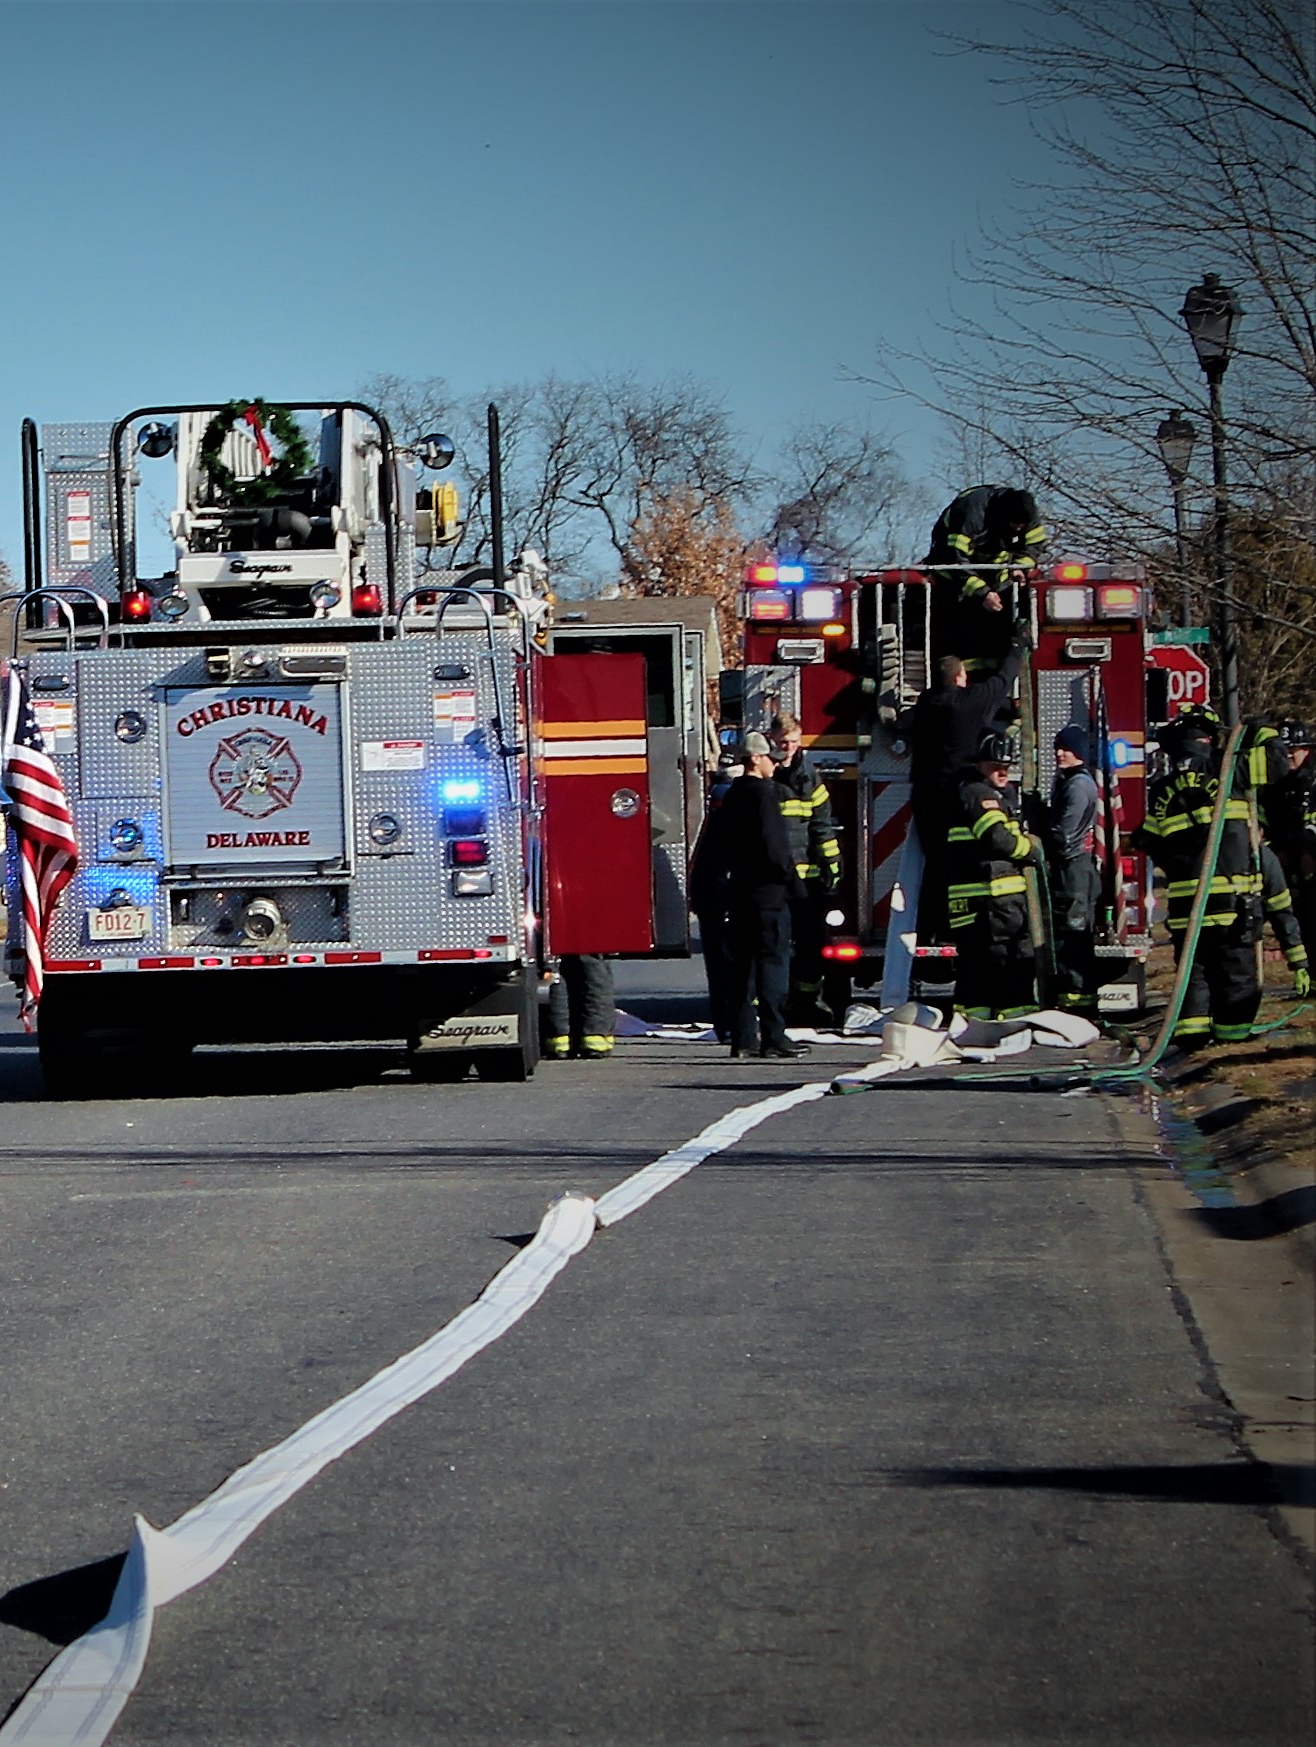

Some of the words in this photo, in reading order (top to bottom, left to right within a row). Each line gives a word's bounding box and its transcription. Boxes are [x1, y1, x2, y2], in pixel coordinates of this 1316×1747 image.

[1167, 670, 1204, 700] OP
[177, 697, 329, 737] CHRISTIANA
[206, 830, 311, 849] DELAWARE
[427, 1022, 509, 1045] Seagrave
